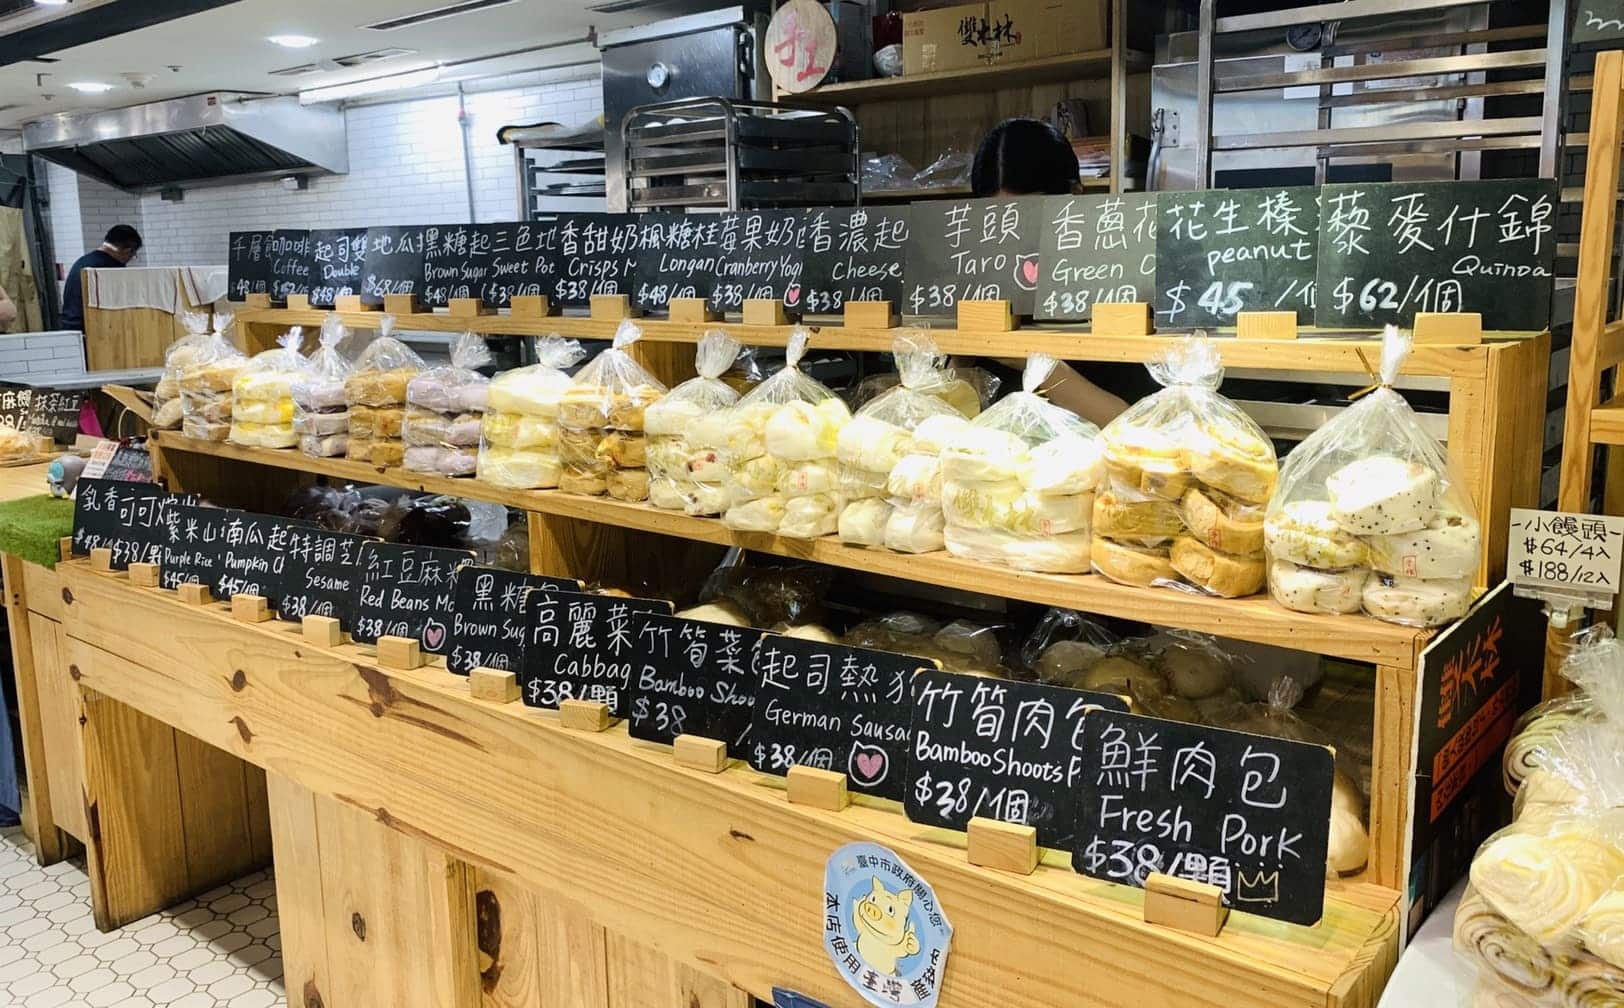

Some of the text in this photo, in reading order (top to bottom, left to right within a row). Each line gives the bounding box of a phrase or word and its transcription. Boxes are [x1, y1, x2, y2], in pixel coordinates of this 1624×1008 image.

[944, 202, 1021, 248] 芋頭
[1166, 190, 1320, 241] 花生榛
[1327, 190, 1553, 255] 藜麥什錦
[371, 231, 423, 255] 地瓜
[425, 227, 491, 259] 黑糖起
[492, 225, 557, 252] 三色地
[561, 220, 637, 256] 香甜奶
[639, 217, 719, 250] 楓糖桂
[720, 214, 806, 254] 莓果奶
[810, 210, 909, 252] 香濃起
[314, 235, 367, 262] 起司雙
[1207, 238, 1312, 276] peanut
[273, 259, 309, 276] Coffee
[323, 264, 360, 280] Double
[425, 261, 487, 283] Brown Sugar
[492, 257, 529, 278] Sweet
[568, 257, 618, 280] Crisps
[660, 253, 715, 278] Longan
[715, 255, 777, 281] Cranberry
[831, 256, 902, 281] Cheese
[951, 250, 1006, 275] Taro
[1052, 258, 1123, 285] Green
[1452, 255, 1552, 277] Quinoa
[81, 484, 119, 511] 乳香
[166, 508, 225, 543] 紫米山
[226, 518, 288, 551] 南瓜起
[164, 548, 213, 568] Purple Rice
[289, 532, 363, 566] 特調芝
[225, 551, 269, 576] Pumpkin
[306, 567, 350, 591] Sesame
[360, 585, 385, 609] Red
[391, 588, 430, 612] Beans
[454, 613, 497, 638] Brown
[534, 594, 632, 656] 高麗菜
[554, 653, 632, 690] Cabbag
[639, 664, 704, 698] Bamboo
[765, 699, 841, 732] German
[1097, 723, 1287, 809] 鮮肉包
[1100, 795, 1303, 860] Fresh Pork
